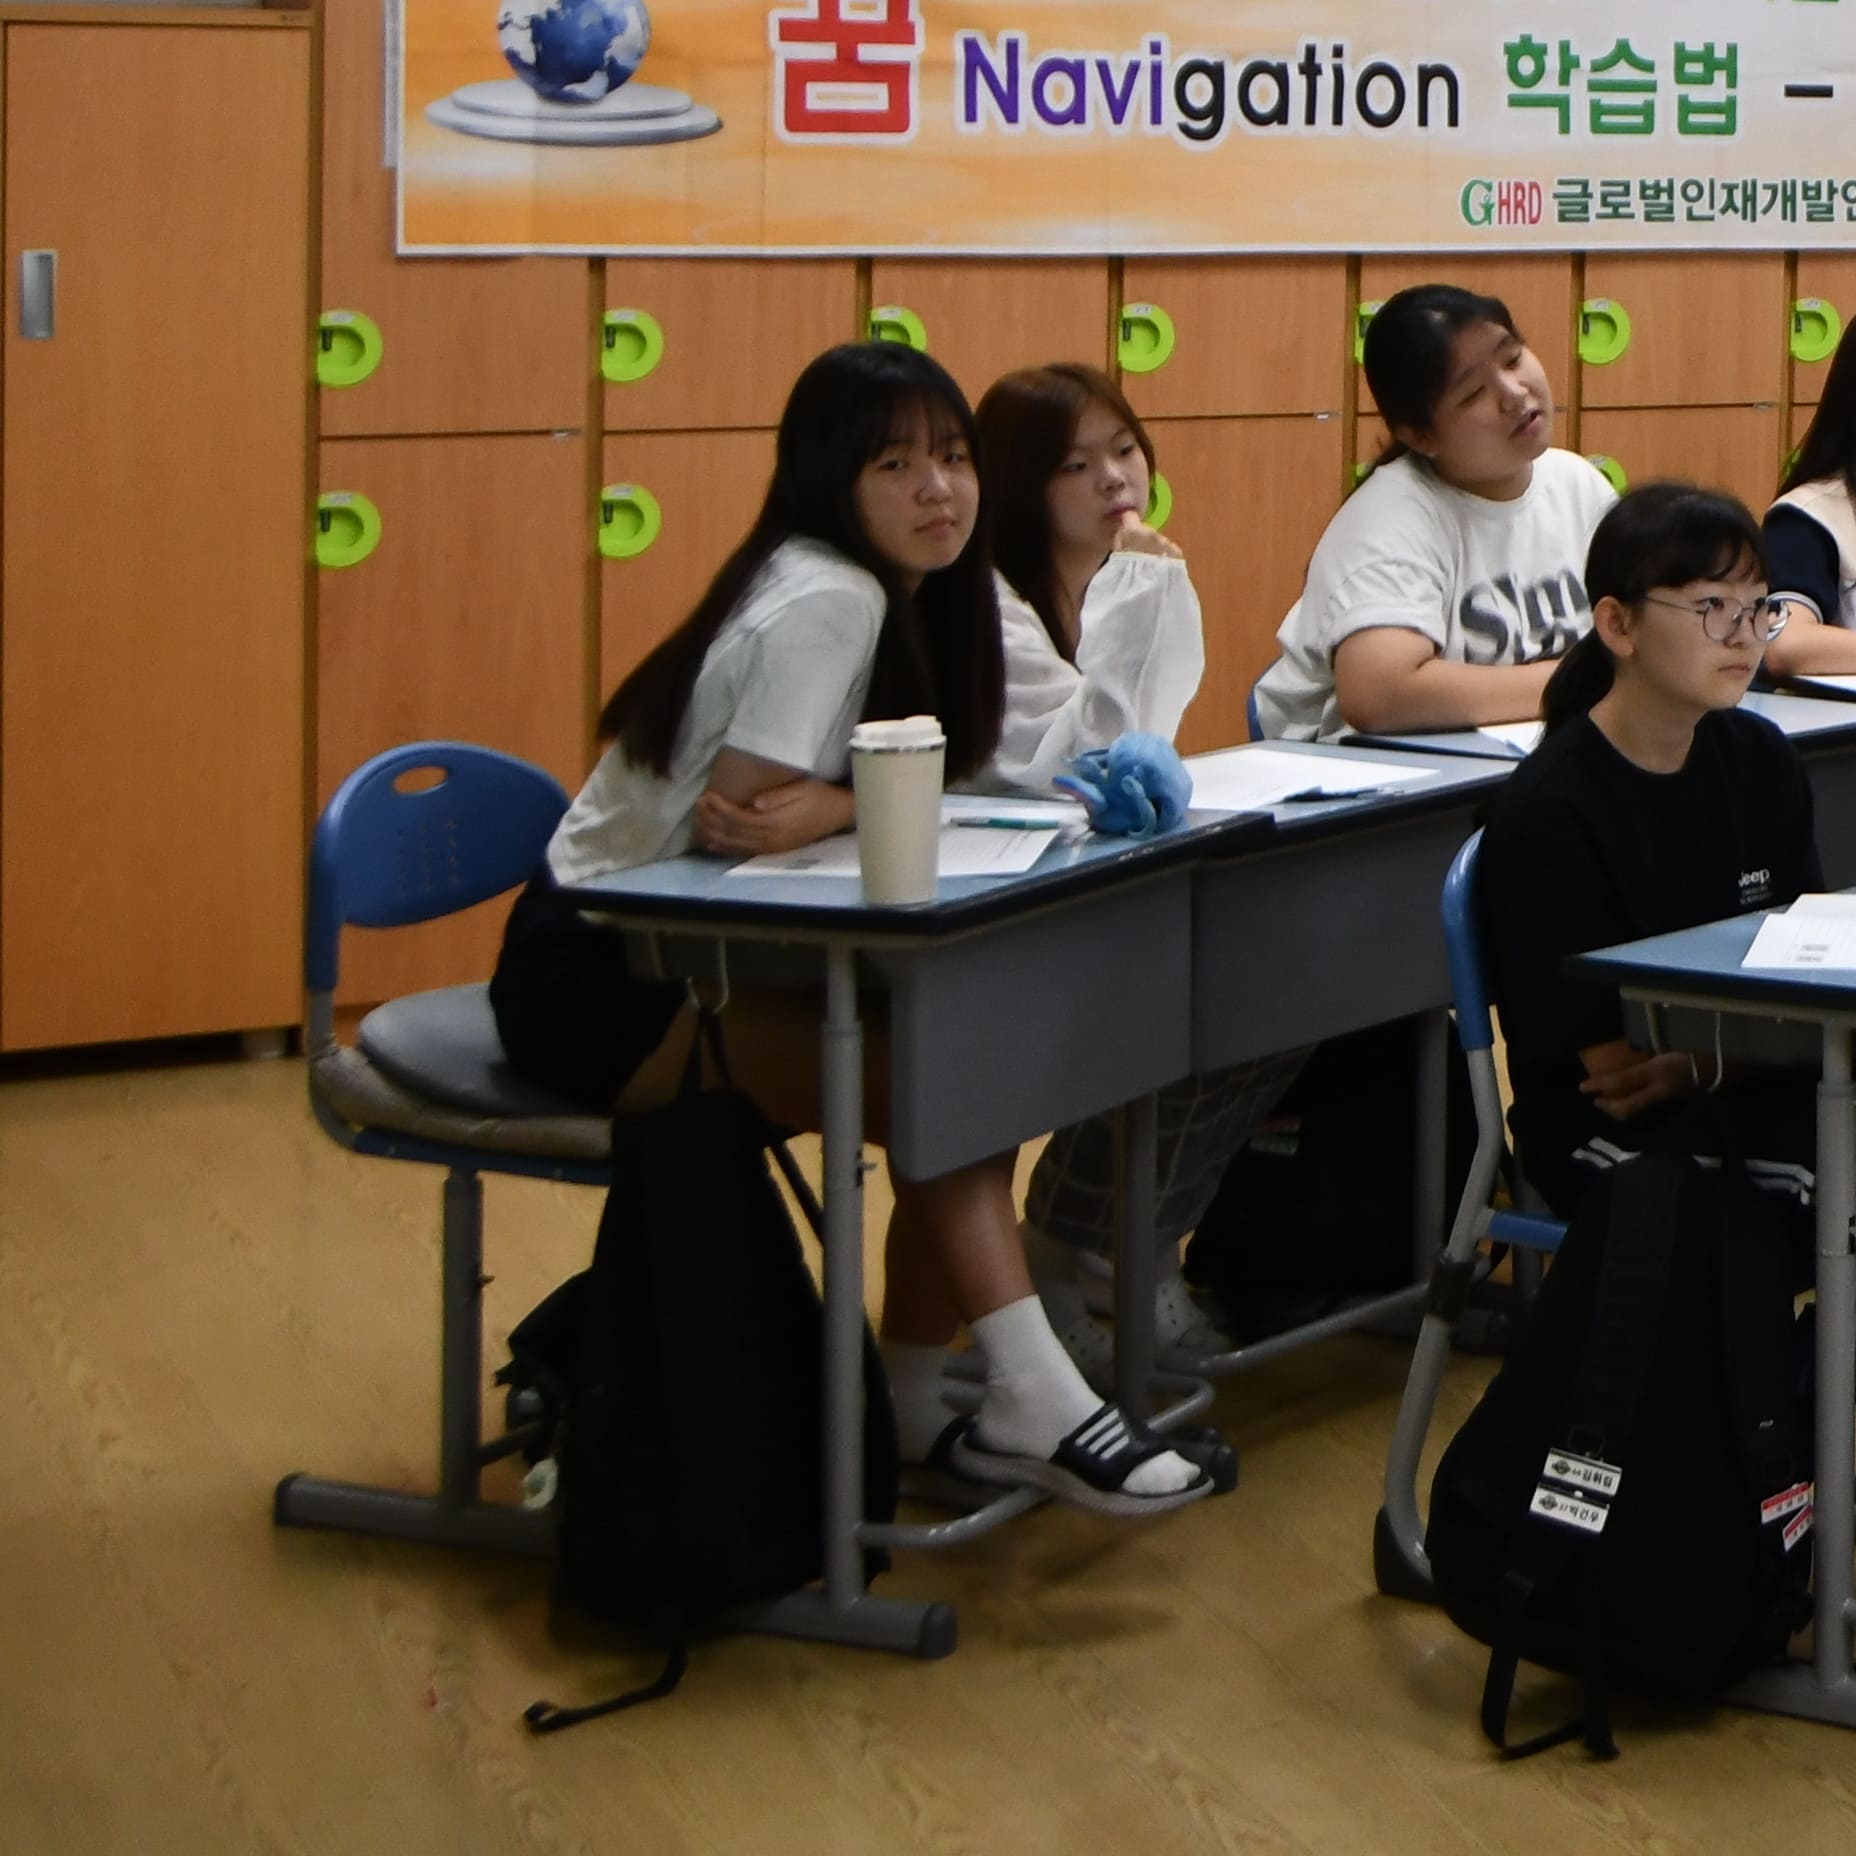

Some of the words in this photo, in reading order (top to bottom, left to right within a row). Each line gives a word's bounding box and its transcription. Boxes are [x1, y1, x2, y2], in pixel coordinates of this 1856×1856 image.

[964, 37, 1460, 142] Navigation
[1504, 34, 1739, 135] 학습법
[1461, 179, 1542, 226] GHRD
